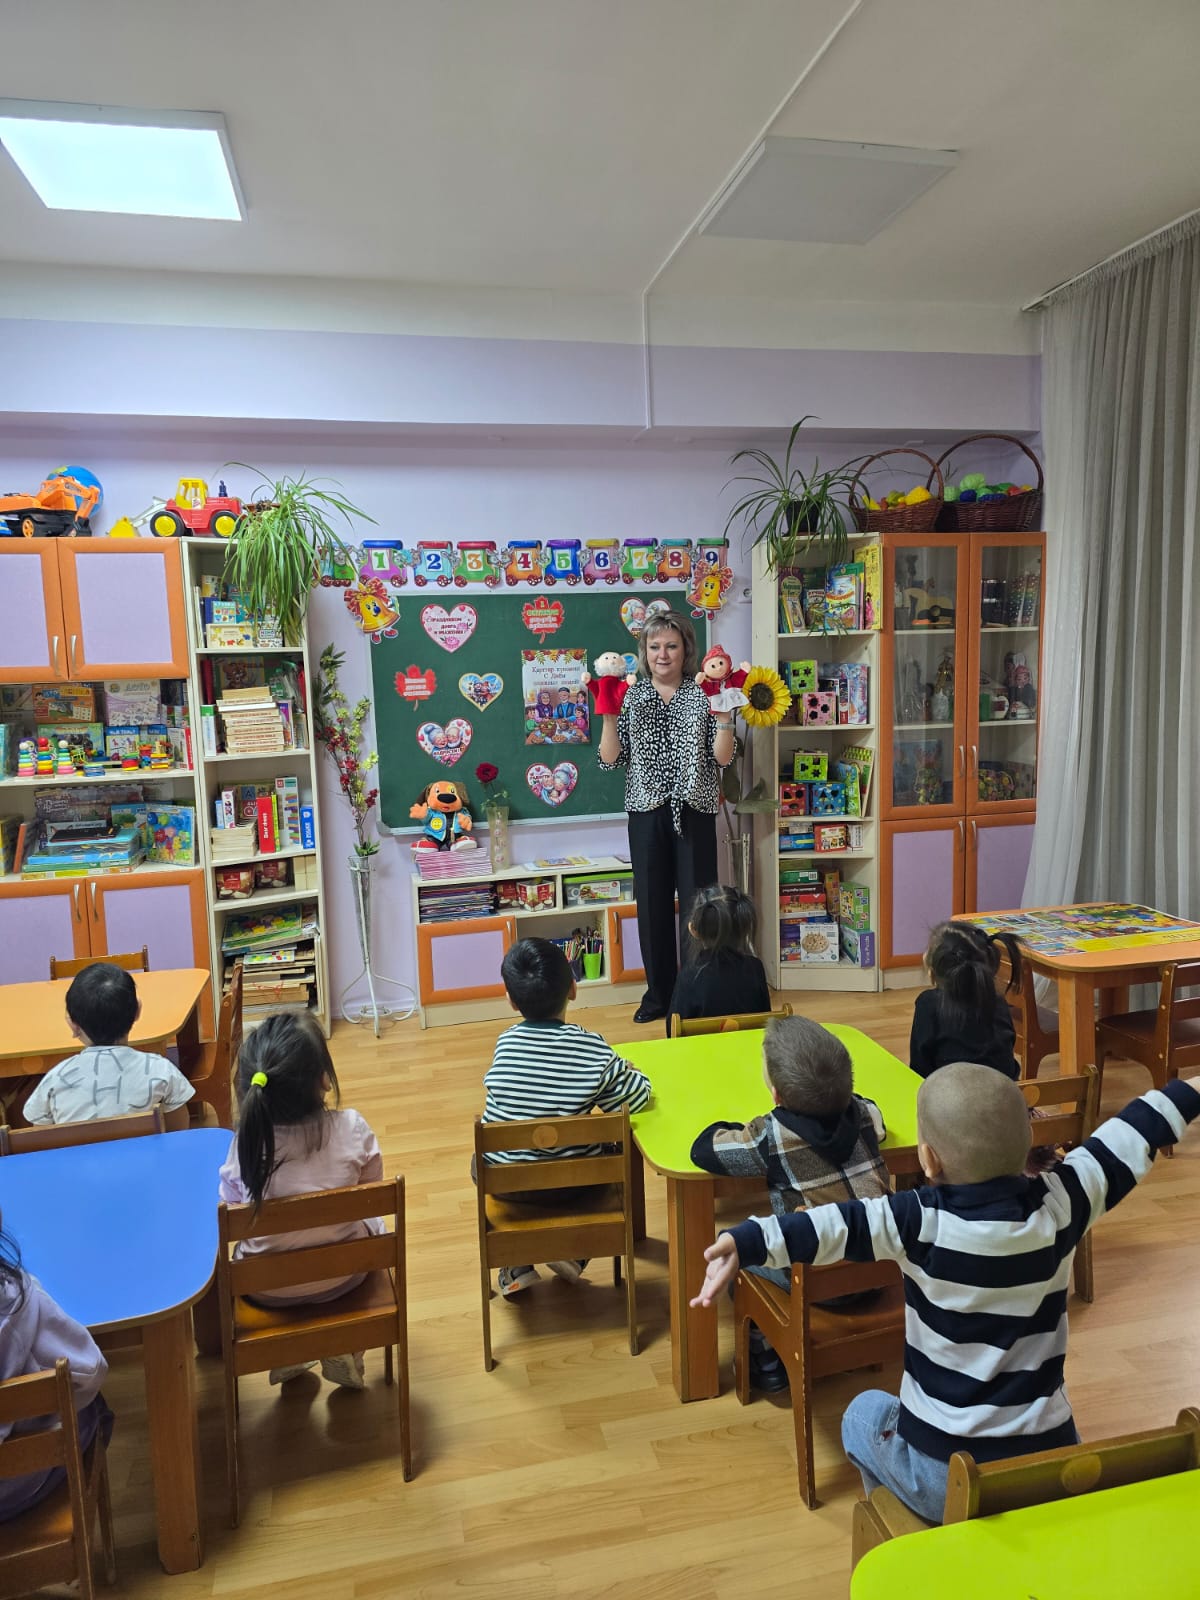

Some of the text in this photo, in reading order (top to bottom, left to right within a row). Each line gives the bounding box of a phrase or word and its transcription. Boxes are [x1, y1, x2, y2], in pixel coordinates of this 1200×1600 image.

[373, 550, 719, 570] 1 2 3 4 5 6 7 8 9
